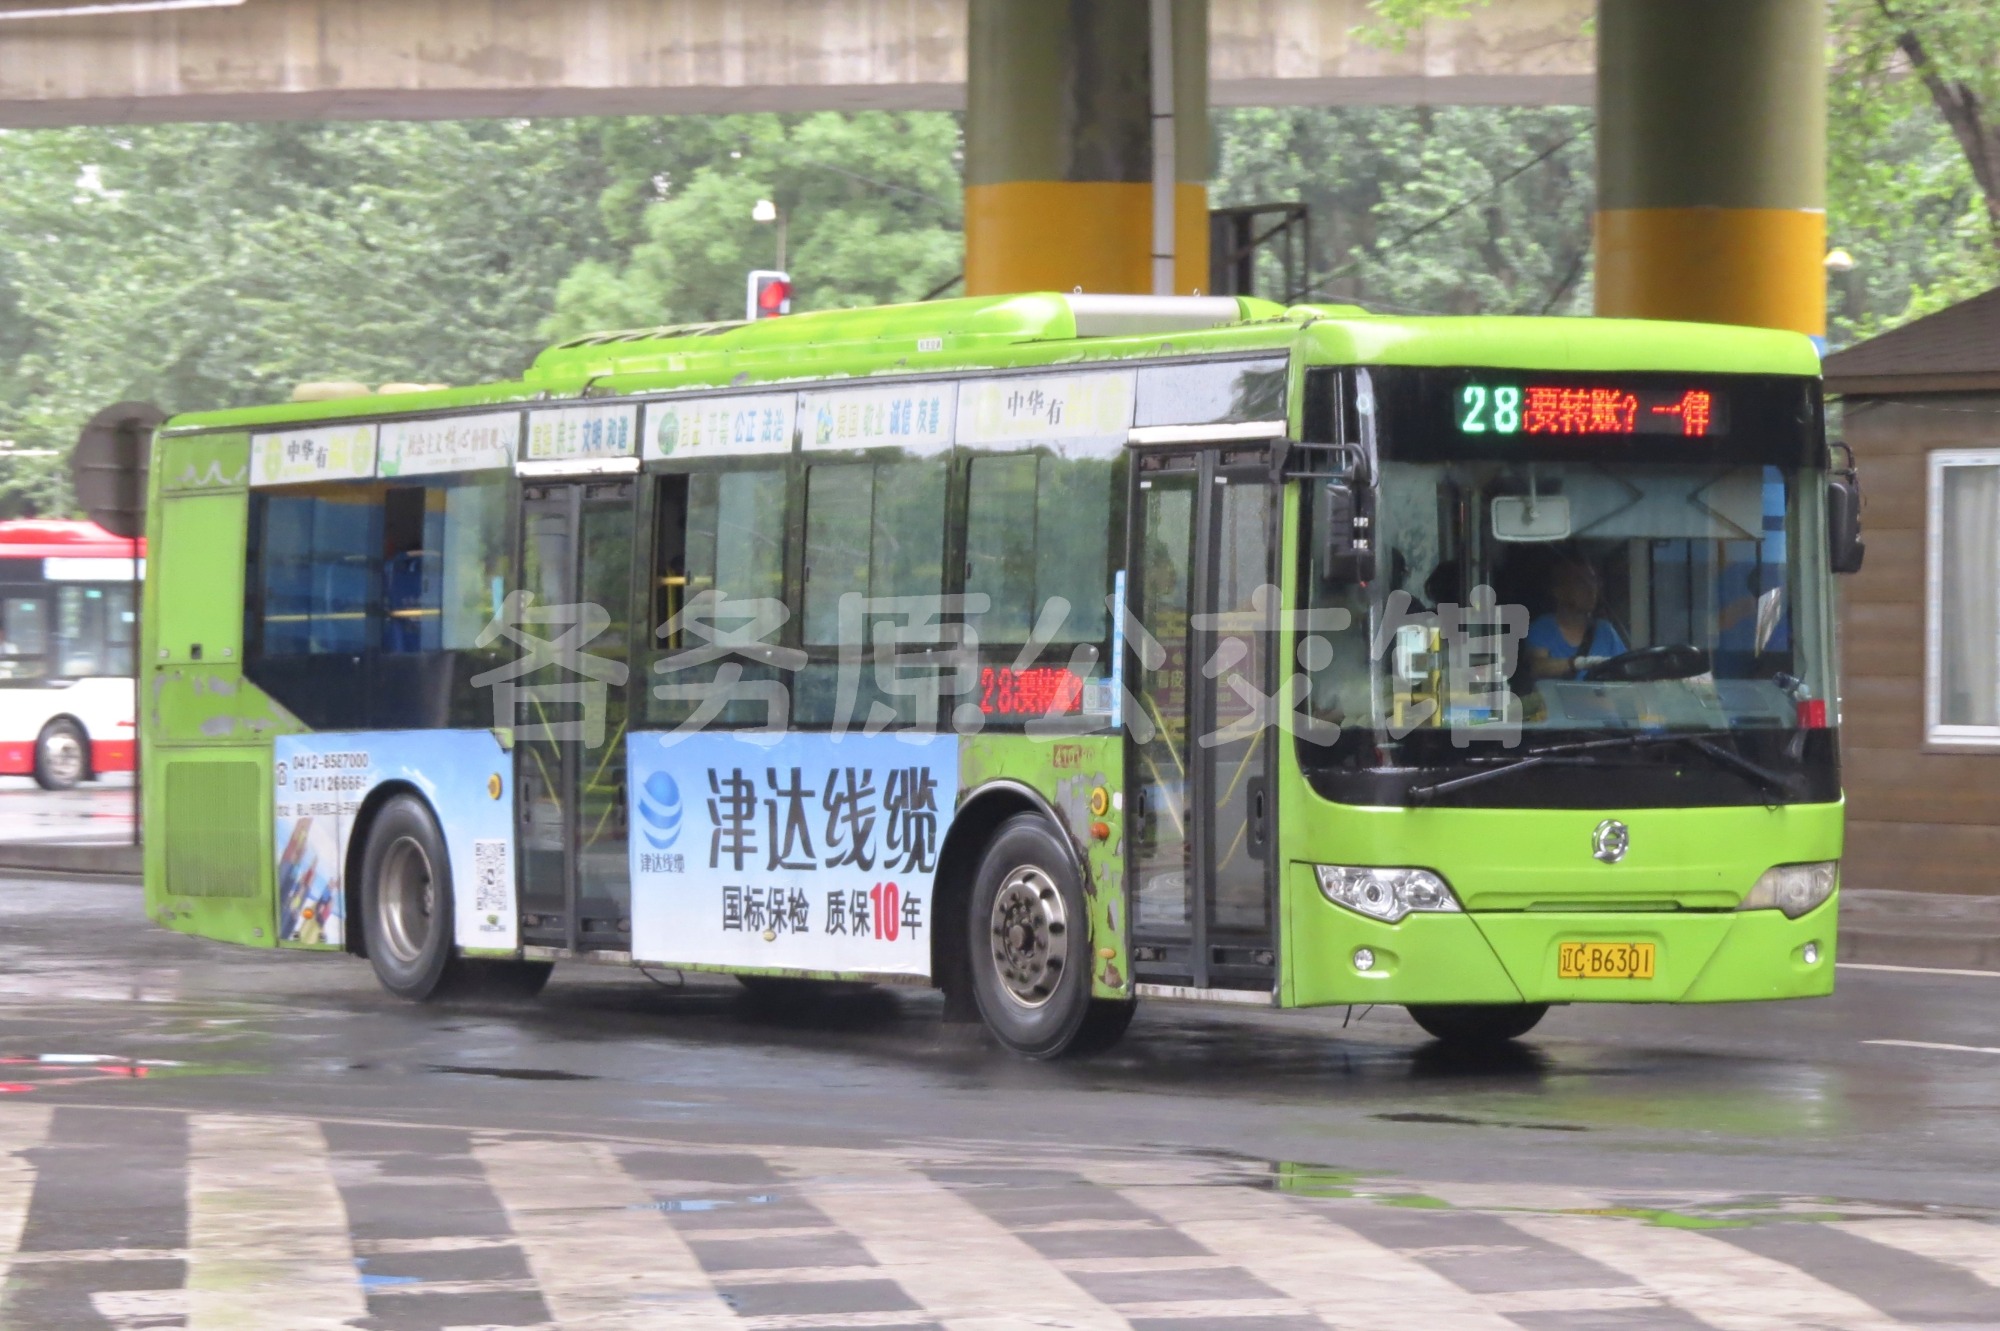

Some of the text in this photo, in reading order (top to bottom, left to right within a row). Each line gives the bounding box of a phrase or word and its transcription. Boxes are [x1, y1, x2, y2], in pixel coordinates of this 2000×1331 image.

[1462, 386, 1519, 432] 28
[1523, 387, 1711, 435] 要转账?一律
[706, 766, 938, 874] 津达线缆
[640, 853, 685, 874] 津达线缆
[722, 881, 922, 942] 国标保检 质保10年
